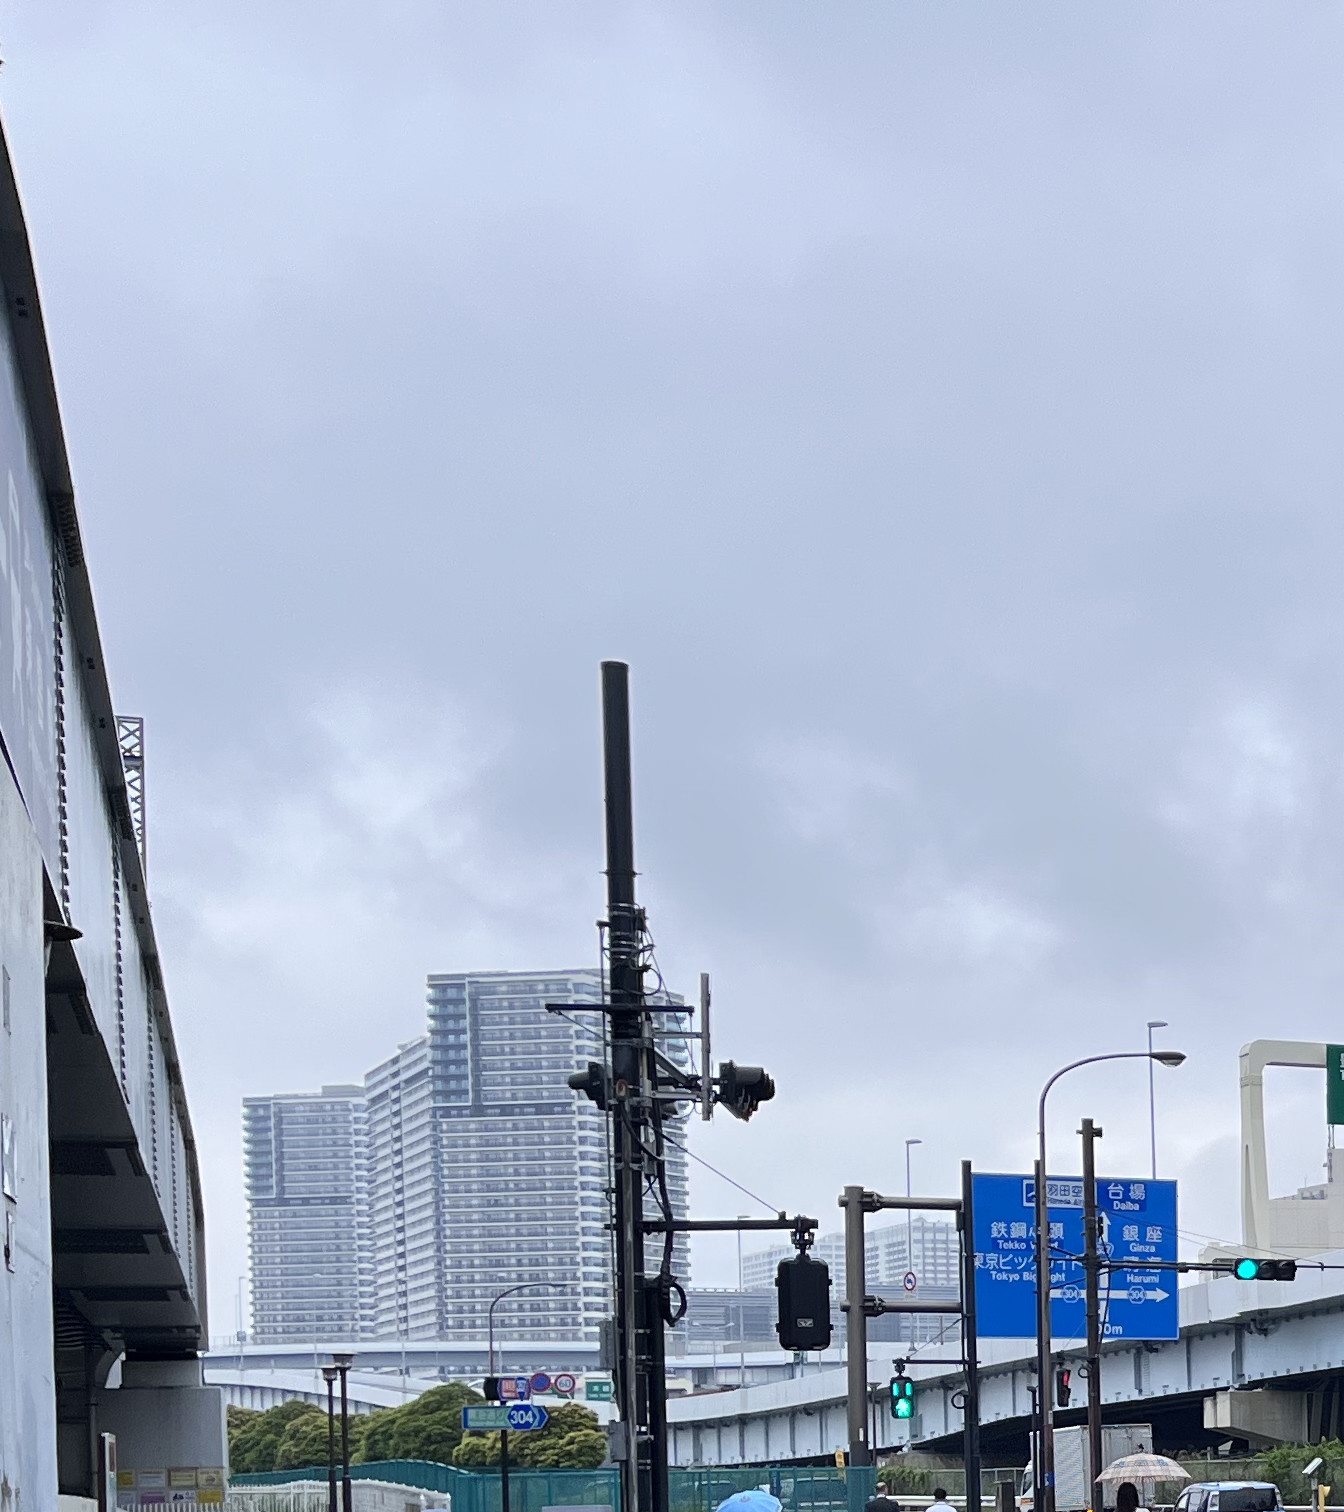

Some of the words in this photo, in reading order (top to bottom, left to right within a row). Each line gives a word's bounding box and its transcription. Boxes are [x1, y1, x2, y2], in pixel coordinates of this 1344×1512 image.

[1047, 1184, 1083, 1197] 羽田空
[1107, 1183, 1146, 1200] 台場
[1113, 1201, 1140, 1210] Daiba
[990, 1221, 1064, 1240] 鉄鋼頭
[1123, 1225, 1163, 1242] 銀座
[997, 1240, 1027, 1250] Tekko
[1129, 1243, 1156, 1253] Ginza
[990, 1271, 1020, 1282] Tokyo
[1126, 1274, 1160, 1283] Harumi
[559, 1379, 571, 1388] 60
[510, 1411, 533, 1424] 304
